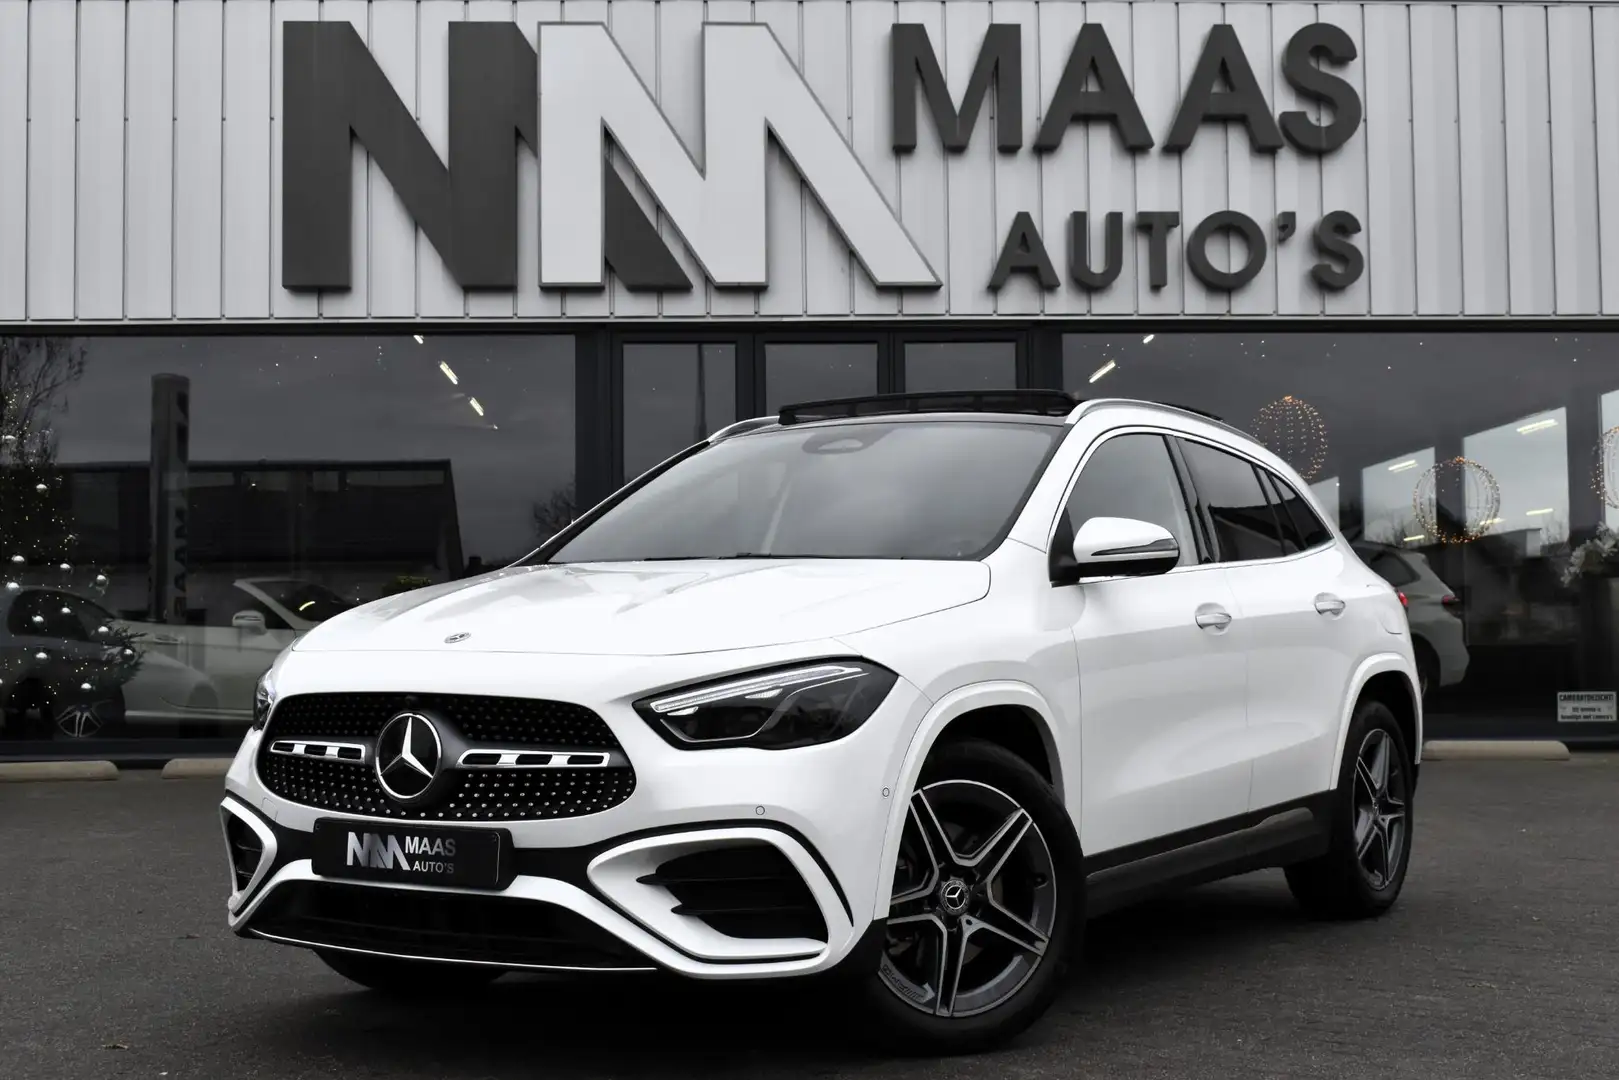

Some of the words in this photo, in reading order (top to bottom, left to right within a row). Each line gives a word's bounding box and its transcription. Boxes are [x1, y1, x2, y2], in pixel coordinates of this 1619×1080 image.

[891, 23, 1363, 155] MAAS
[989, 210, 1366, 290] AUTO'S
[405, 835, 456, 856] MAAS
[413, 861, 454, 874] AUTO'S
